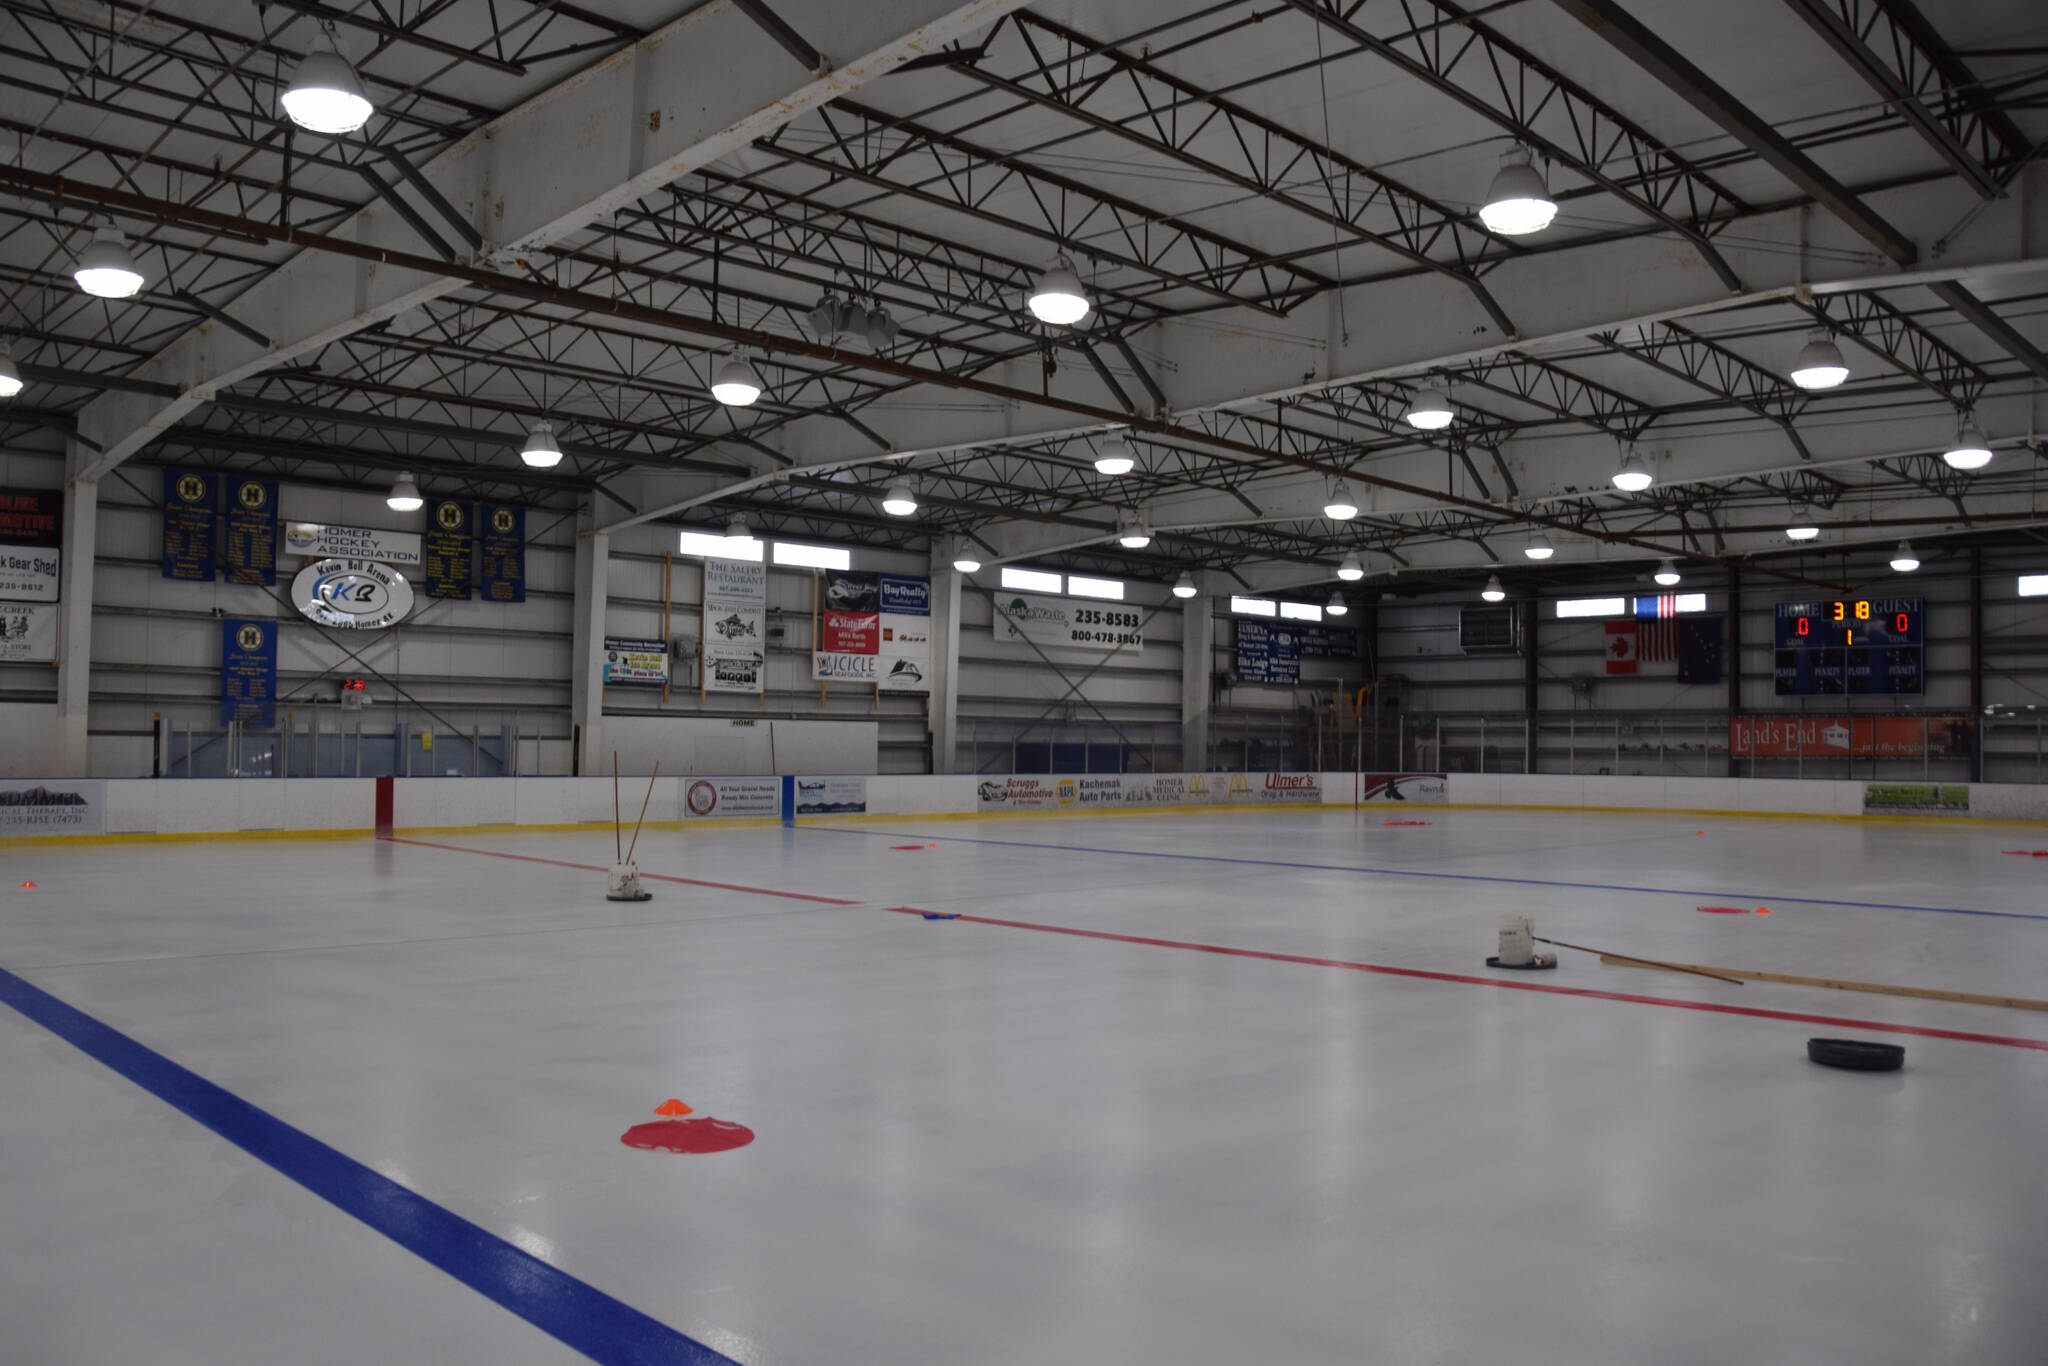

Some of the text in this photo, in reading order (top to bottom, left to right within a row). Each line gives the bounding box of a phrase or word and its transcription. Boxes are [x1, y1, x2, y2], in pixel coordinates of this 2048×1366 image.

[316, 536, 381, 549] HOCKEY
[316, 545, 419, 561] ASSOCIATION
[9, 557, 32, 571] Gear
[33, 558, 56, 577] Shed
[316, 560, 392, 586] Kevin Bell Arena
[711, 562, 762, 575] THE SALTRY
[708, 571, 764, 585] RESTAURANT
[884, 583, 927, 601] Bay Realty
[1833, 601, 1845, 621] 3
[1855, 600, 1870, 620] 18
[1873, 599, 1919, 613] GUEST
[1797, 616, 1809, 636] 0
[1896, 612, 1909, 632] 0
[833, 655, 876, 673] ICICLE
[1815, 666, 1840, 677] PENALTY
[1889, 665, 1915, 676] PENALTY
[732, 719, 757, 728] HOME
[1736, 721, 1816, 753] Land's End
[1881, 742, 1897, 753] the
[1006, 778, 1039, 790] Scruggs
[1079, 778, 1121, 790] Kachemak
[1156, 777, 1183, 786] HOMER
[1265, 772, 1314, 790] Ulmer's
[1008, 788, 1054, 799] Automotive
[1079, 789, 1122, 802] Auto Parts
[1153, 785, 1184, 794] MEDICAL
[1261, 789, 1277, 799] Drug
[1285, 789, 1320, 798] Hardware
[1156, 793, 1181, 801] CLINIC
[53, 815, 82, 825] (7473)
